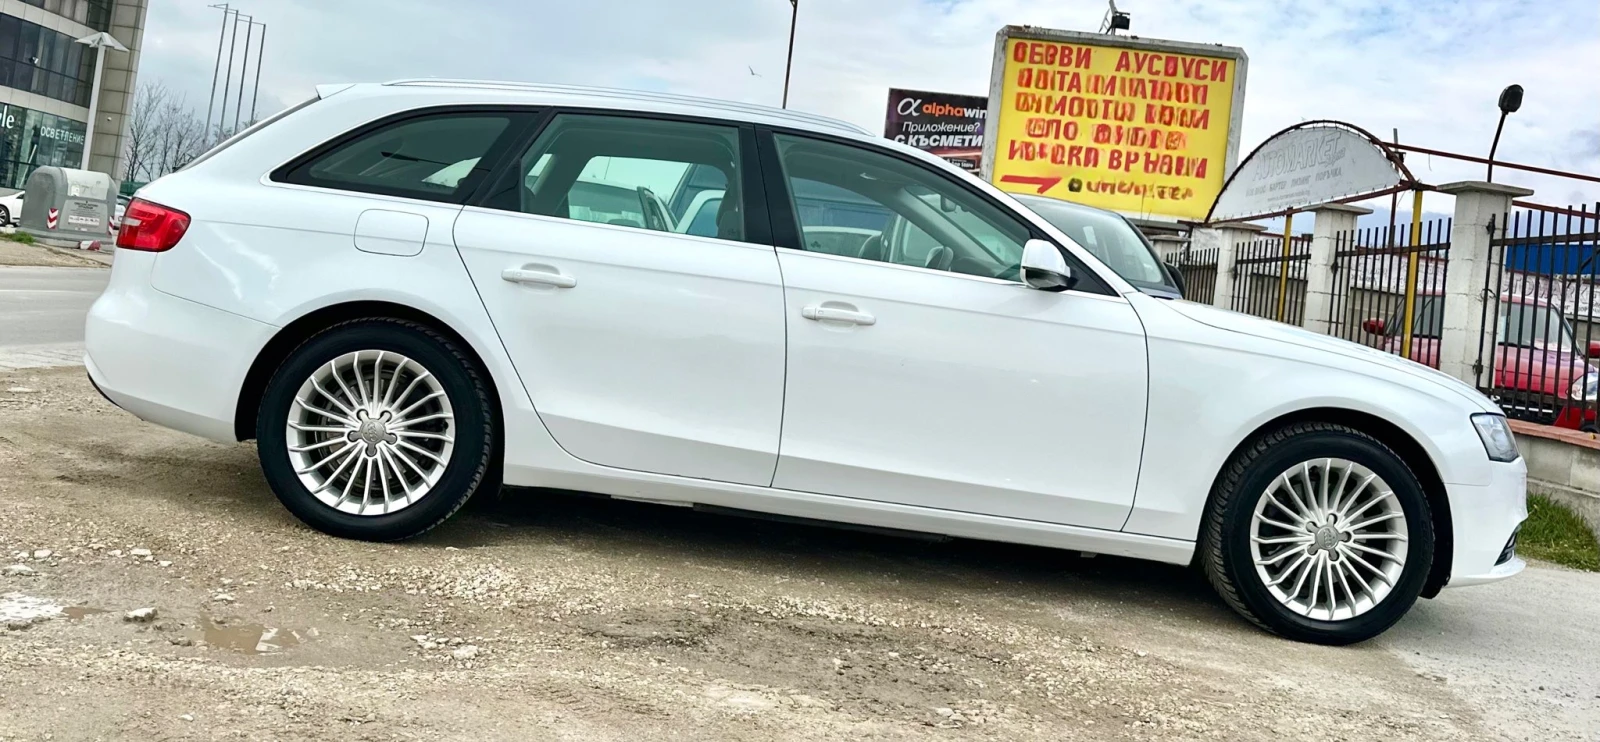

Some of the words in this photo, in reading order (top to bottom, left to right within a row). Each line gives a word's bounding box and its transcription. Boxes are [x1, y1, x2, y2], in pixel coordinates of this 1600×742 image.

[40, 126, 85, 145] ОСВЕТЛЕНИЕ
[902, 121, 981, 133] Приложение?
[1252, 131, 1342, 182] AUTOMARKET
